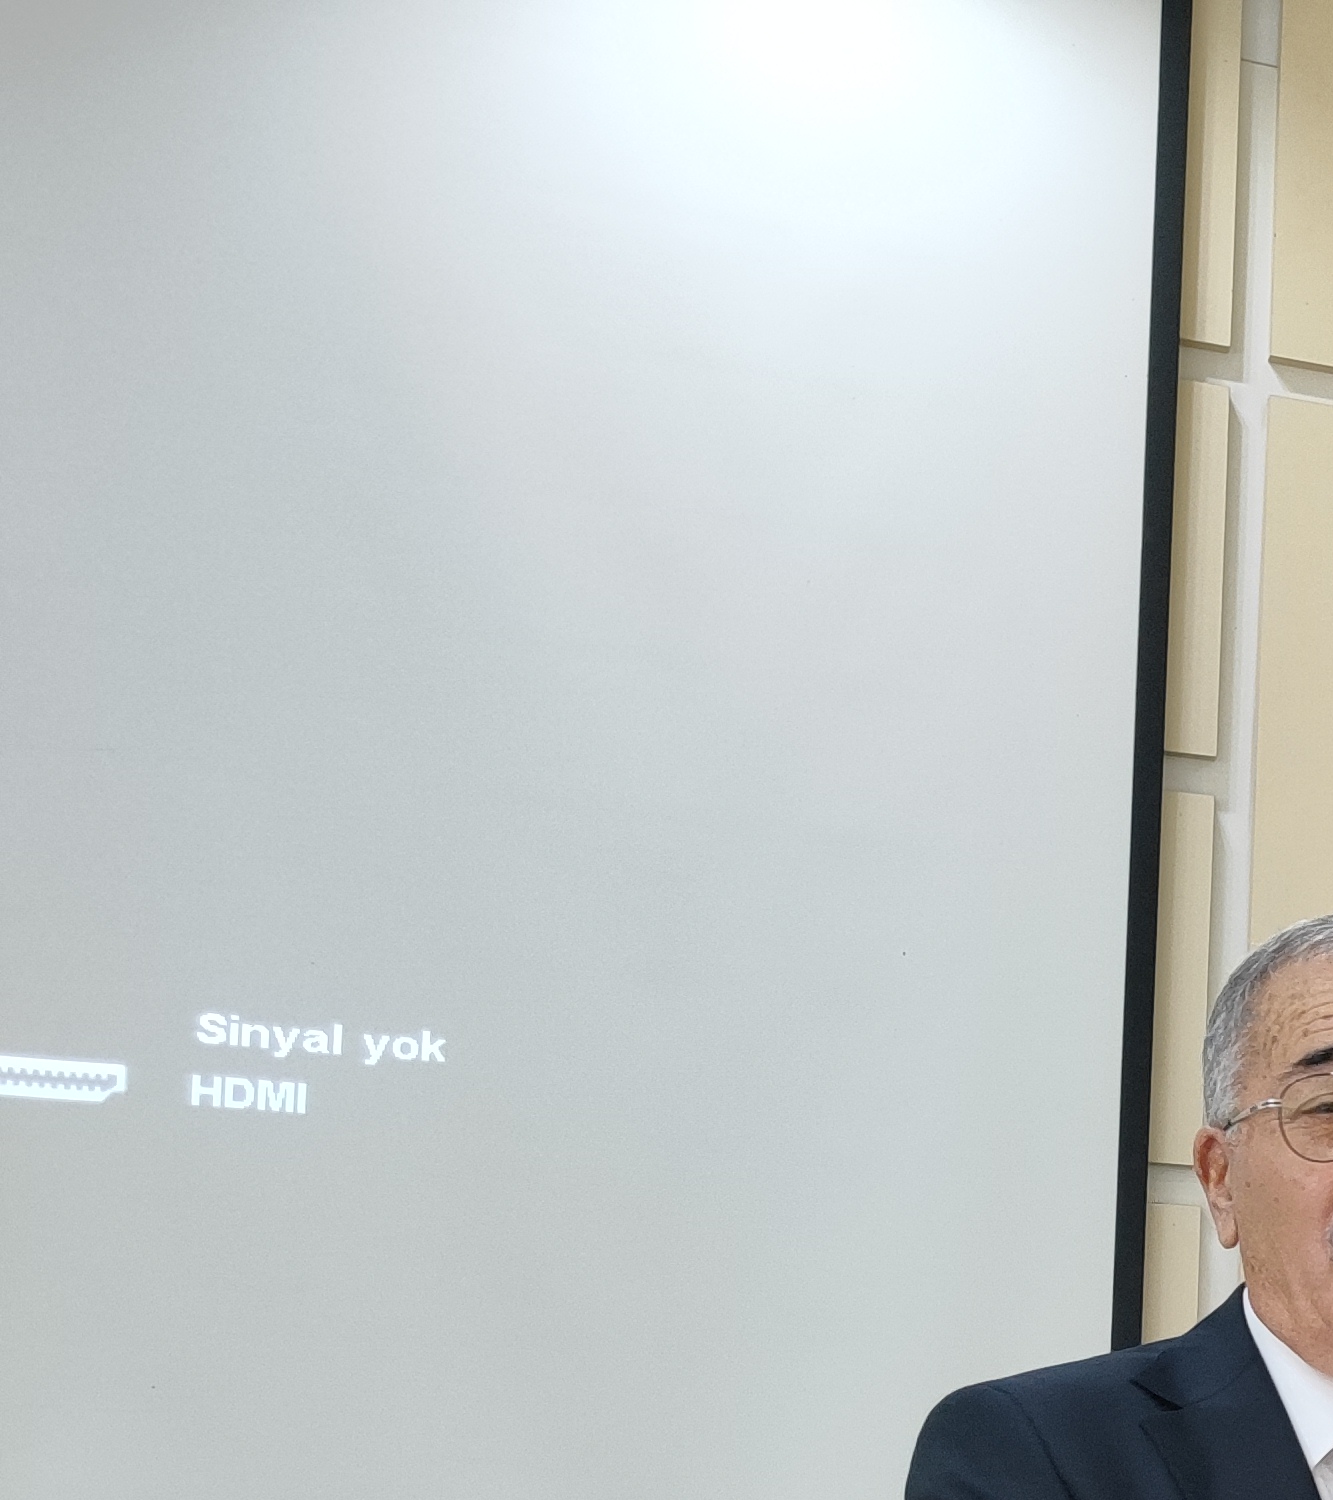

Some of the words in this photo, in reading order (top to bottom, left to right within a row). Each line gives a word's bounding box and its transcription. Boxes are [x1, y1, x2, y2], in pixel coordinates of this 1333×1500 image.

[196, 1012, 344, 1058] Sinyal
[363, 1030, 446, 1065] yok
[190, 1074, 308, 1115] HDMI
